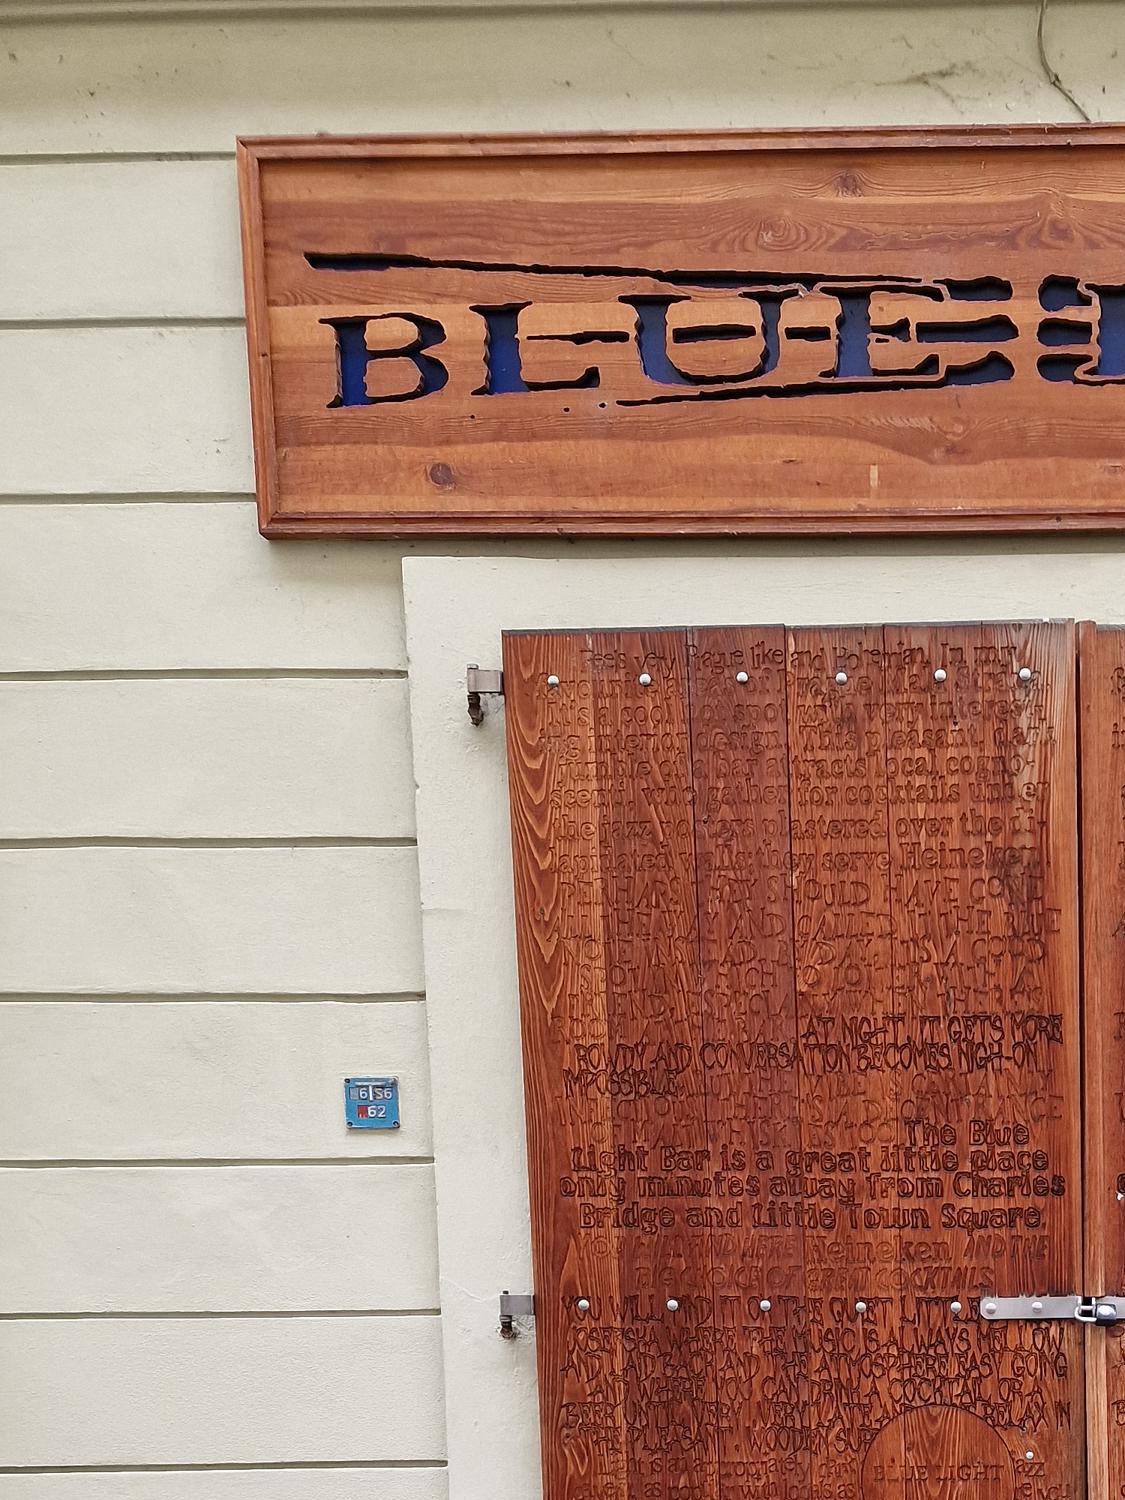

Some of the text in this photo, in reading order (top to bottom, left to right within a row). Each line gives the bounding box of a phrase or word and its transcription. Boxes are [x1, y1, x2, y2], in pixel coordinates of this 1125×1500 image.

[318, 284, 946, 408] BLUE
[367, 1105, 387, 1118] 62
[905, 1118, 1030, 1147] The Blue
[570, 1143, 1049, 1177] Light Bar is a great little place
[559, 1171, 1066, 1204] only minutes away from Charles
[579, 1201, 677, 1235] Bridge
[686, 1200, 744, 1229] and
[751, 1200, 837, 1229] Little
[840, 1201, 931, 1230] Town
[872, 1463, 1005, 1482] BLUE LIGHT
